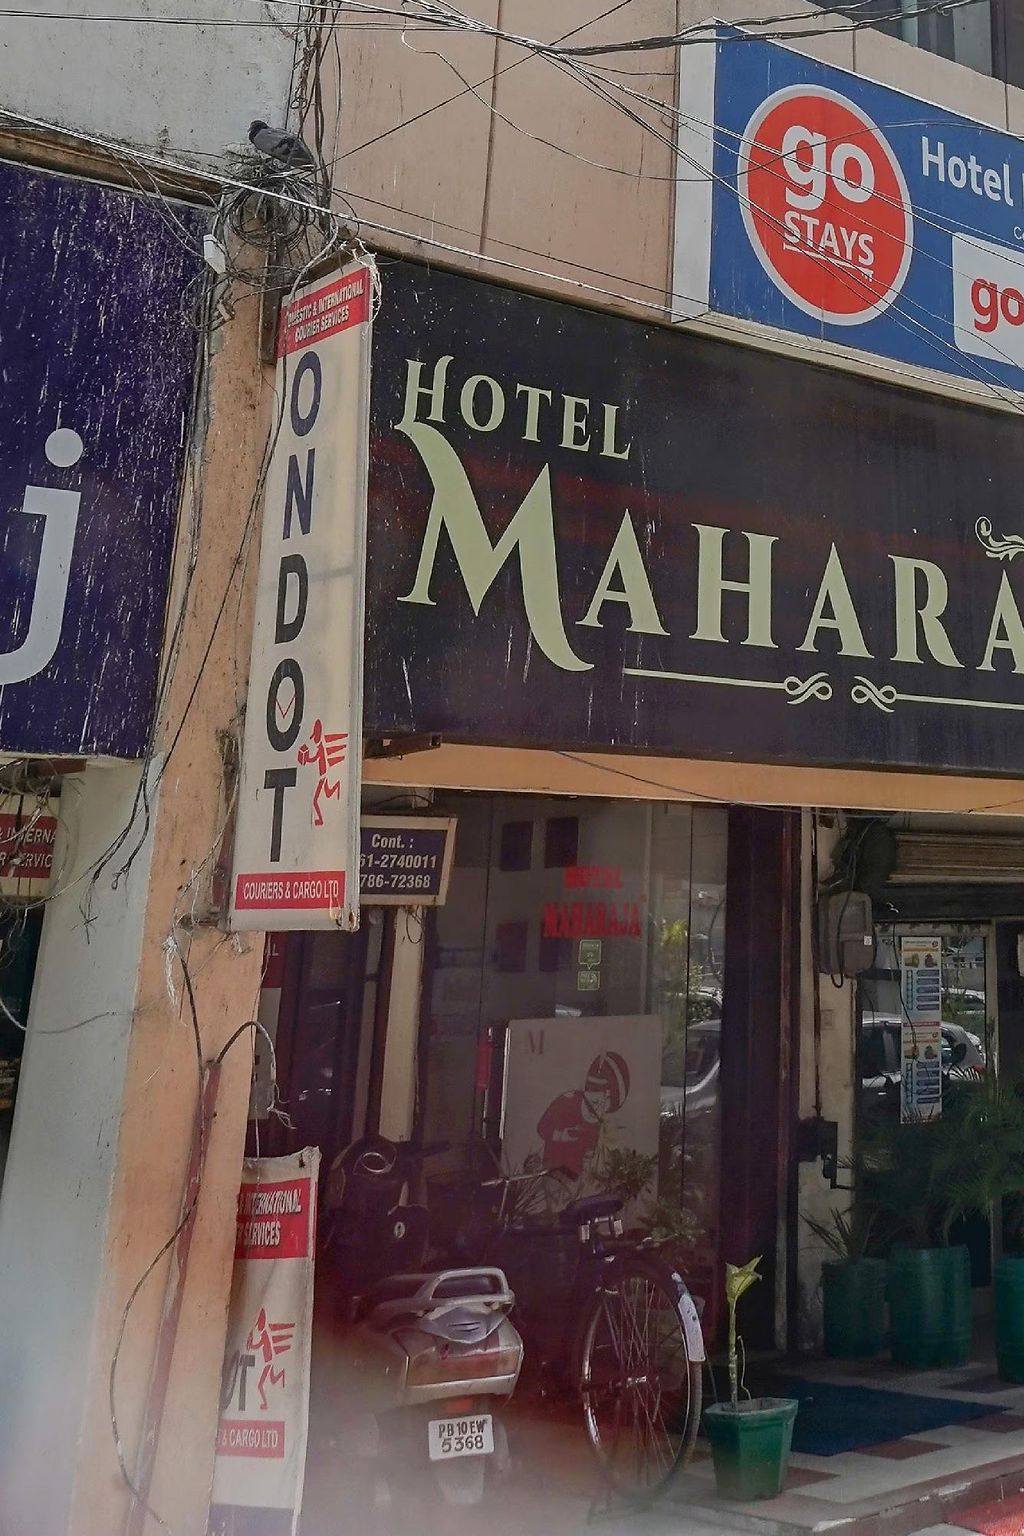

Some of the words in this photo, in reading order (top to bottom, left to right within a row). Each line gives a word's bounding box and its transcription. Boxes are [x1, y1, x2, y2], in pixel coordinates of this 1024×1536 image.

[781, 125, 875, 210] go
[920, 136, 1014, 206] Hotel
[783, 211, 875, 267] STAYS
[319, 279, 364, 314] INTERNATIONAL
[295, 319, 320, 342] COURIER
[321, 305, 350, 332] SERVICES
[402, 355, 630, 460] HOTEL
[264, 350, 323, 863] ONDOT
[371, 834, 405, 850] Cont.
[243, 879, 284, 901] COURIERS
[285, 880, 291, 898] &
[293, 879, 321, 899] CARGO
[323, 879, 338, 898] LTD
[229, 1427, 260, 1449] CARGO
[261, 1428, 279, 1448] LTD
[441, 1434, 484, 1453] 5368
